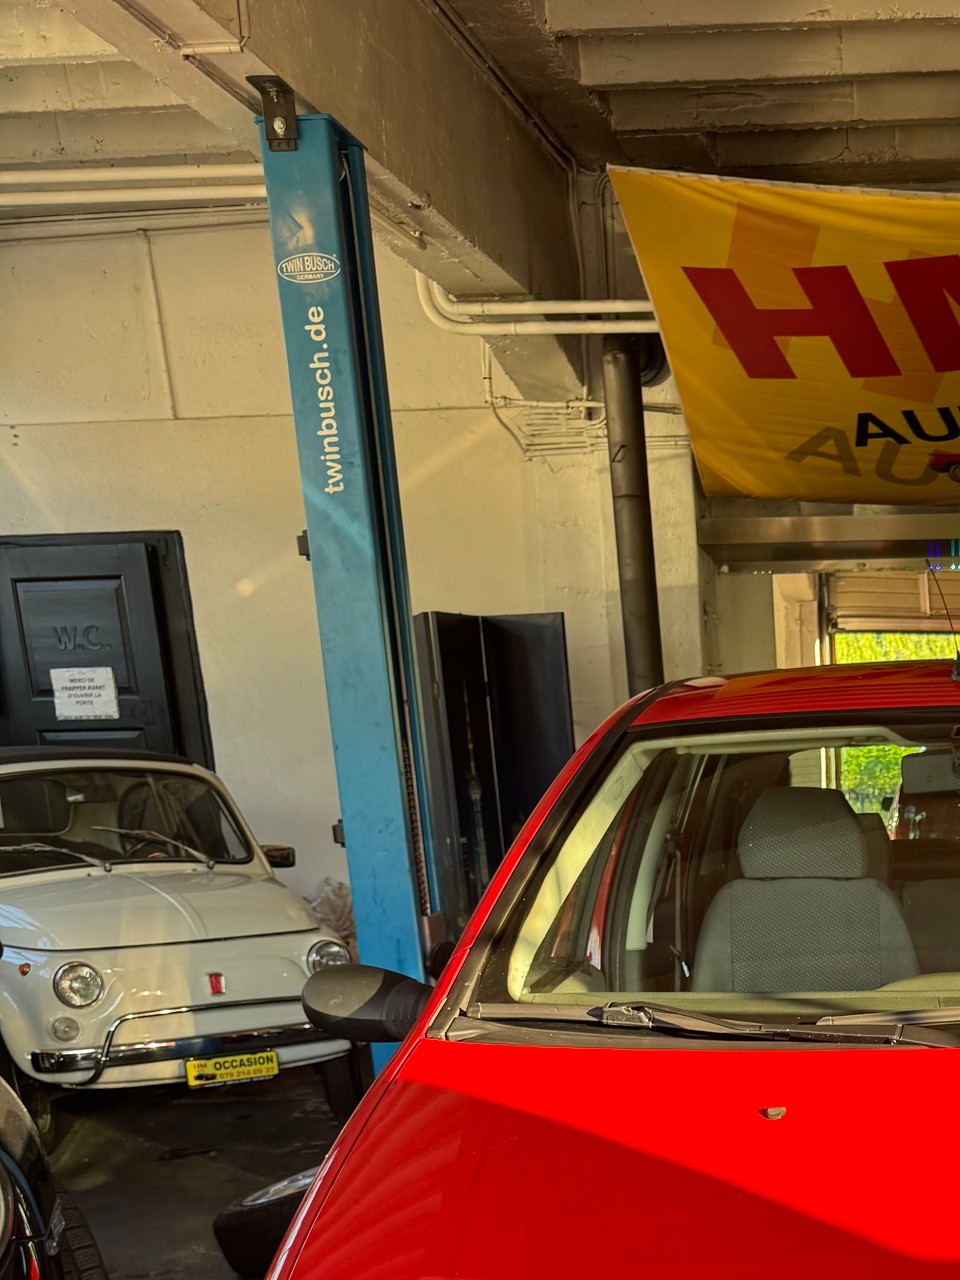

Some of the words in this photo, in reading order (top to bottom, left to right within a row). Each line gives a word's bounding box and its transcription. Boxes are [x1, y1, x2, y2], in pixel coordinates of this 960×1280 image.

[281, 257, 303, 272] TWIN
[304, 256, 335, 271] BUSCH
[296, 273, 325, 281] GERMANY
[304, 305, 344, 494] twinbusch.de
[53, 624, 112, 651] W.C.
[214, 1055, 274, 1071] OCCASION
